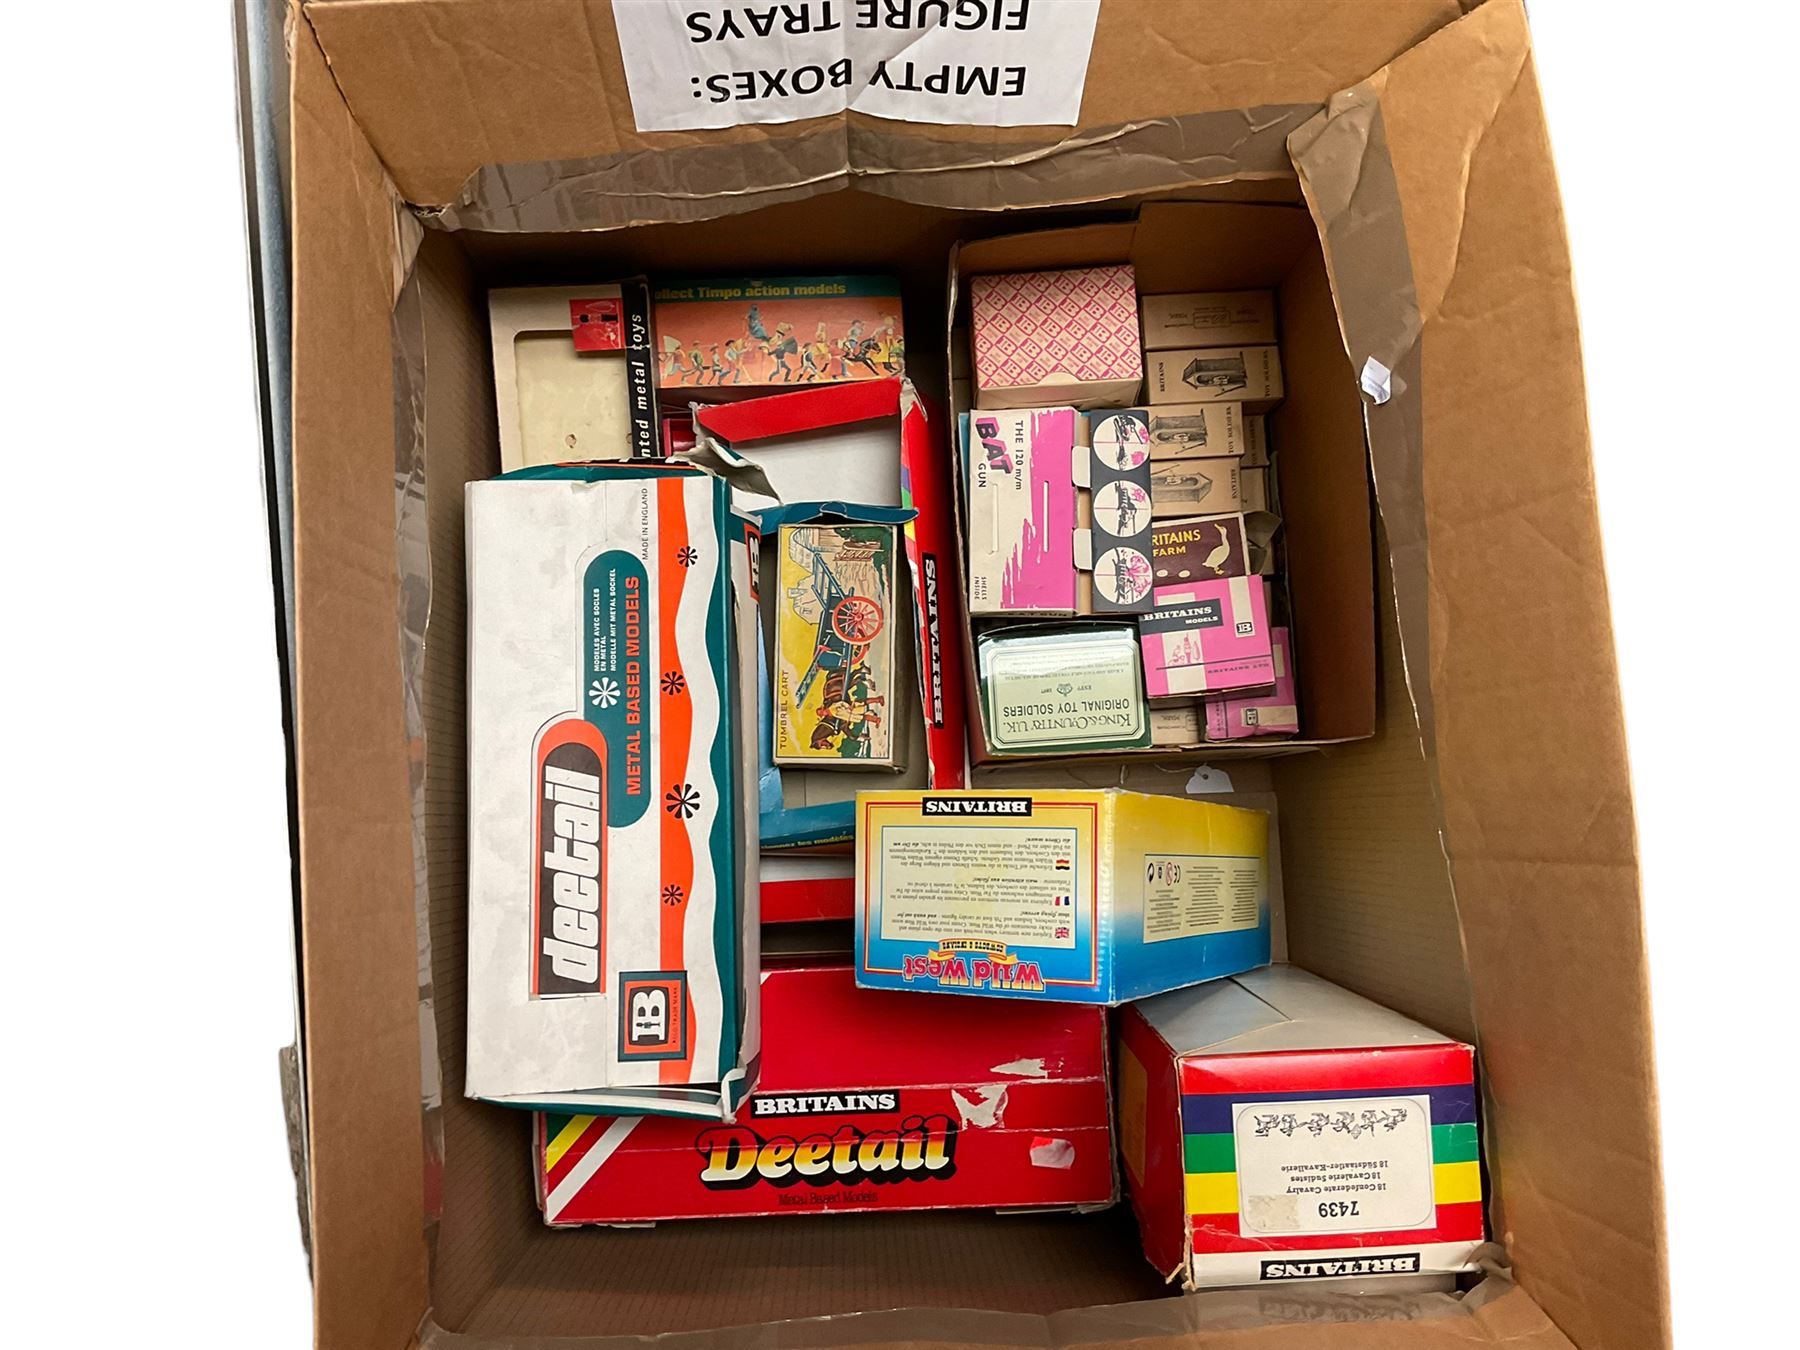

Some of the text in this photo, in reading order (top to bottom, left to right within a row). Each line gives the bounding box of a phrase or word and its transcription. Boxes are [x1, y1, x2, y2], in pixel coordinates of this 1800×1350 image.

[686, 0, 1029, 44] FIGURE TRAYS
[691, 58, 1027, 104] EMPTY BOXES:
[655, 283, 845, 300] ollect Timpo action models
[631, 314, 651, 458] nted metal toys
[975, 416, 1014, 475] BAT
[1014, 420, 1023, 491] THE 120 m/m
[978, 463, 987, 488] GUN
[641, 527, 648, 536] IN
[1152, 529, 1201, 546] RITAINS
[641, 537, 649, 560] MADE
[1153, 545, 1187, 557] FARM
[592, 588, 600, 616] SOCLES
[1143, 606, 1213, 621] BRITAINS
[1185, 616, 1219, 625] MODELS
[924, 559, 943, 723] BRITAINS
[600, 660, 607, 672] EN
[625, 576, 641, 795] METAL BASED MODELS
[779, 669, 789, 750] TUMBREL CART
[1003, 699, 1130, 717] ORIGINAL TOY SOLDIERS
[1003, 721, 1028, 733] U.K.
[925, 800, 1028, 813] BRITAINS
[543, 765, 600, 984] deetail
[903, 956, 1045, 992] Wild West
[754, 1092, 895, 1116] BRITAINS
[698, 1117, 955, 1183] Deetail
[1281, 1160, 1388, 1173] 18 Südstaatler-Kavallerie
[1290, 1171, 1381, 1184] 18 Cavalerie Sudistes
[1285, 1183, 1387, 1195] 18 Confederate Cavalry
[1318, 1201, 1360, 1218] 7439
[1265, 1257, 1416, 1278] BRITAINS
